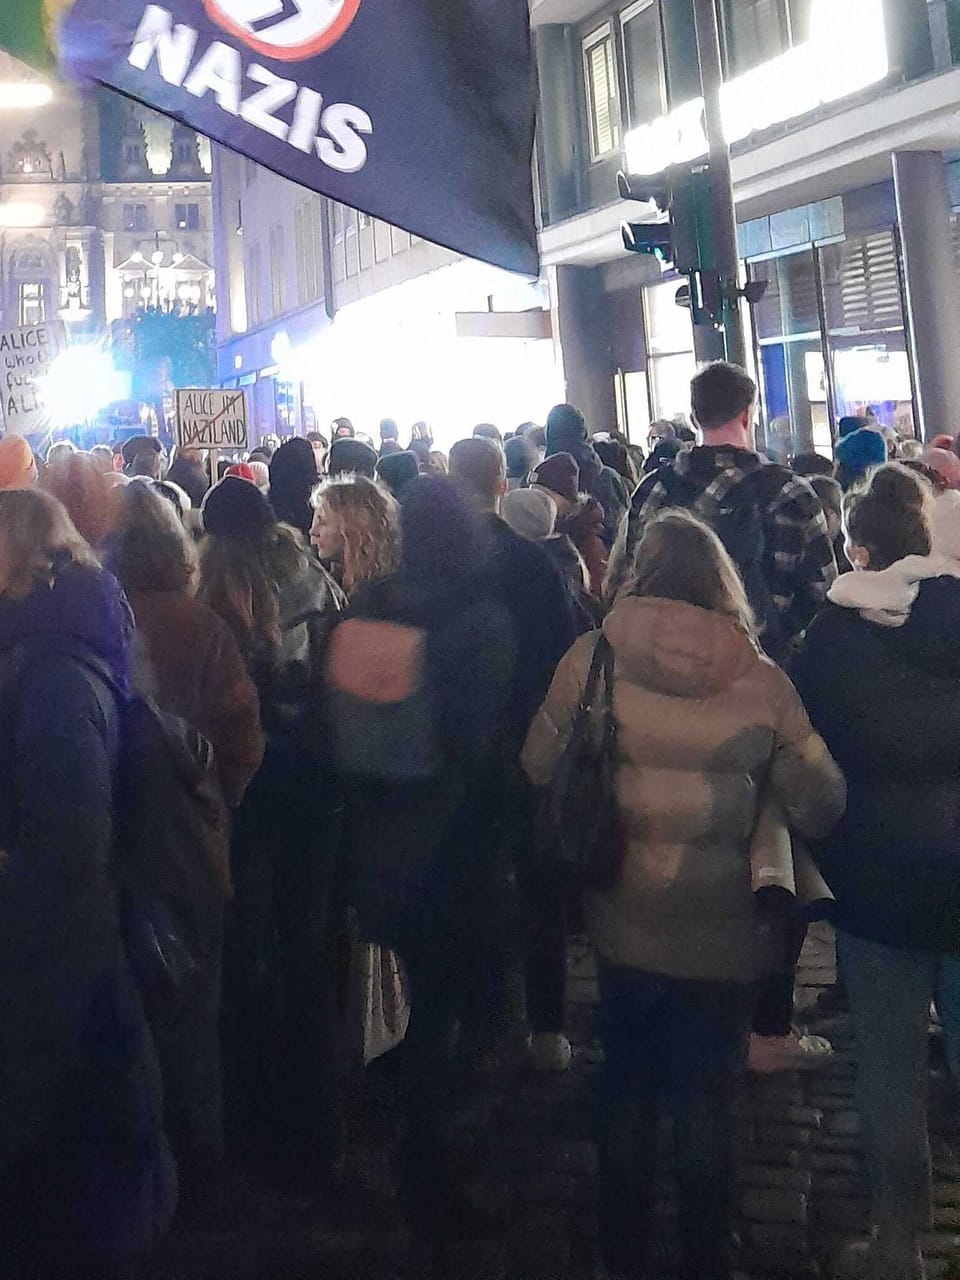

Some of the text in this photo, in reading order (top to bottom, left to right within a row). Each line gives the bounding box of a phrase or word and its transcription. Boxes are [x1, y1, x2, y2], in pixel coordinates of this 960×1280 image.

[127, 4, 373, 173] NAZIS
[6, 370, 38, 392] fuc
[184, 393, 214, 416] ALICE
[183, 419, 246, 445] NAZILAND
